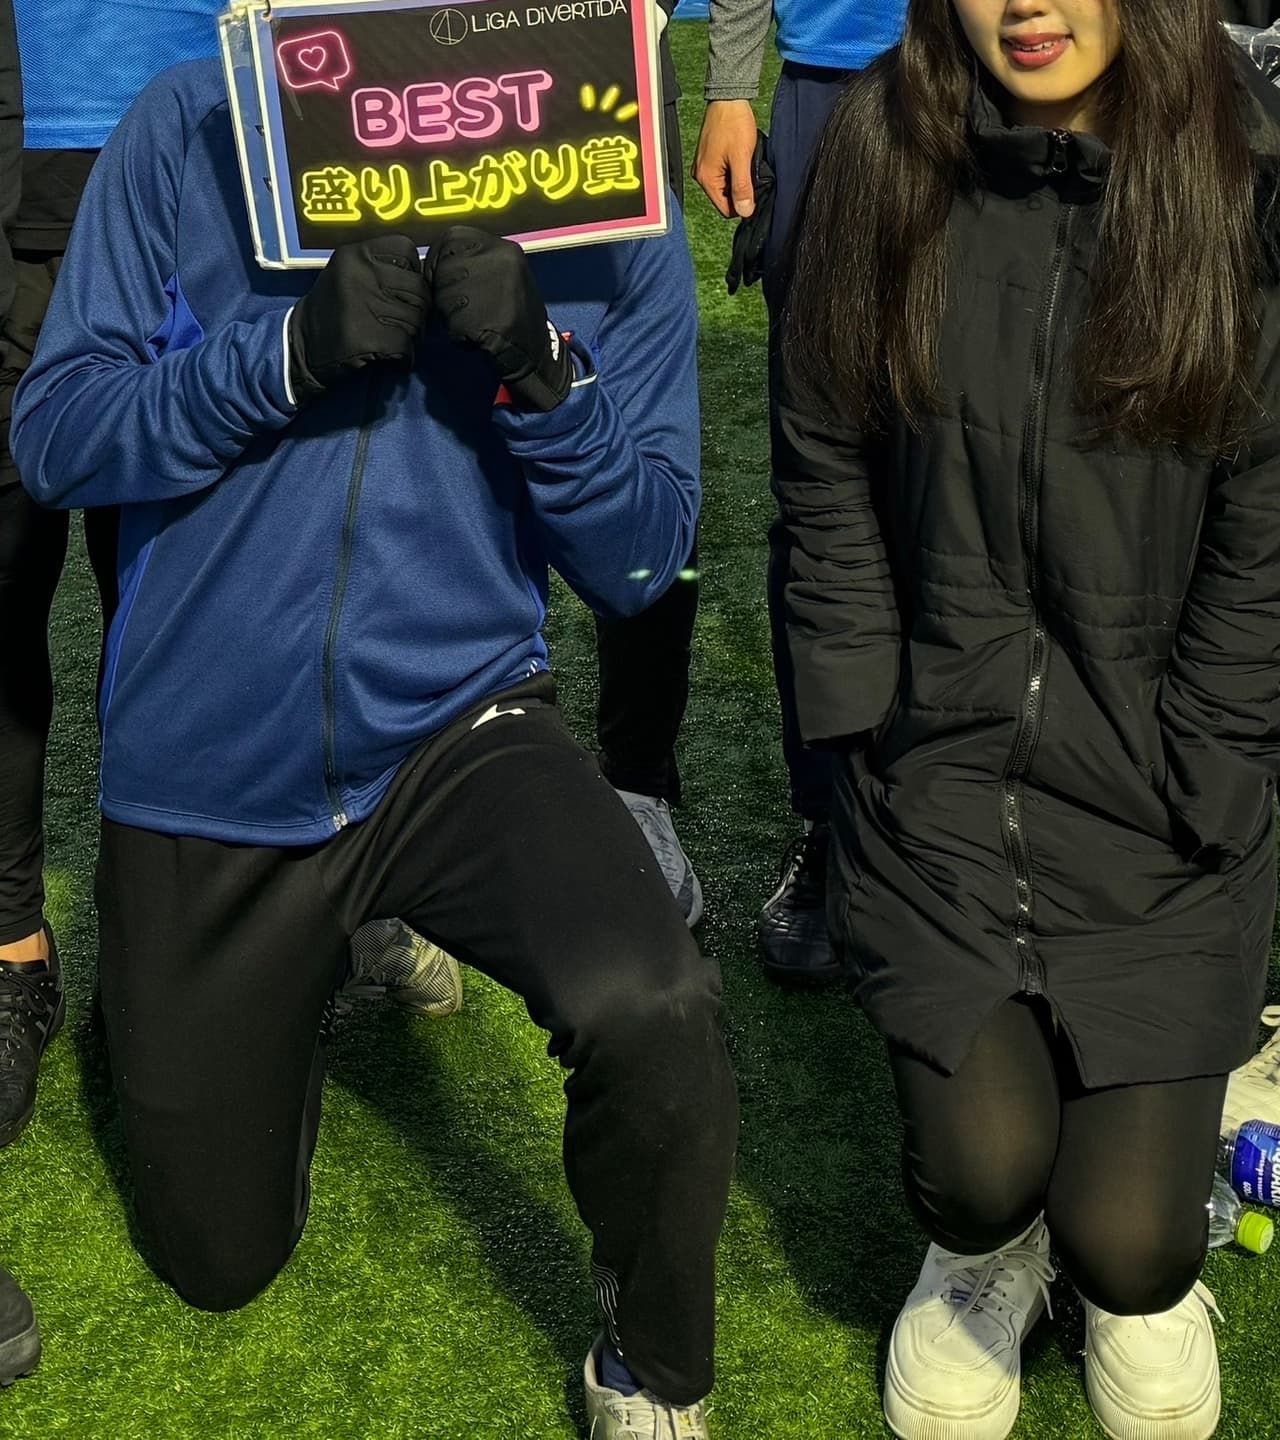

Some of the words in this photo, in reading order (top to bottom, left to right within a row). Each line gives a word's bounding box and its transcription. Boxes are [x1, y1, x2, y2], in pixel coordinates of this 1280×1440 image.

[351, 70, 552, 148] BEST
[301, 135, 640, 222] 盛り上がり賞
